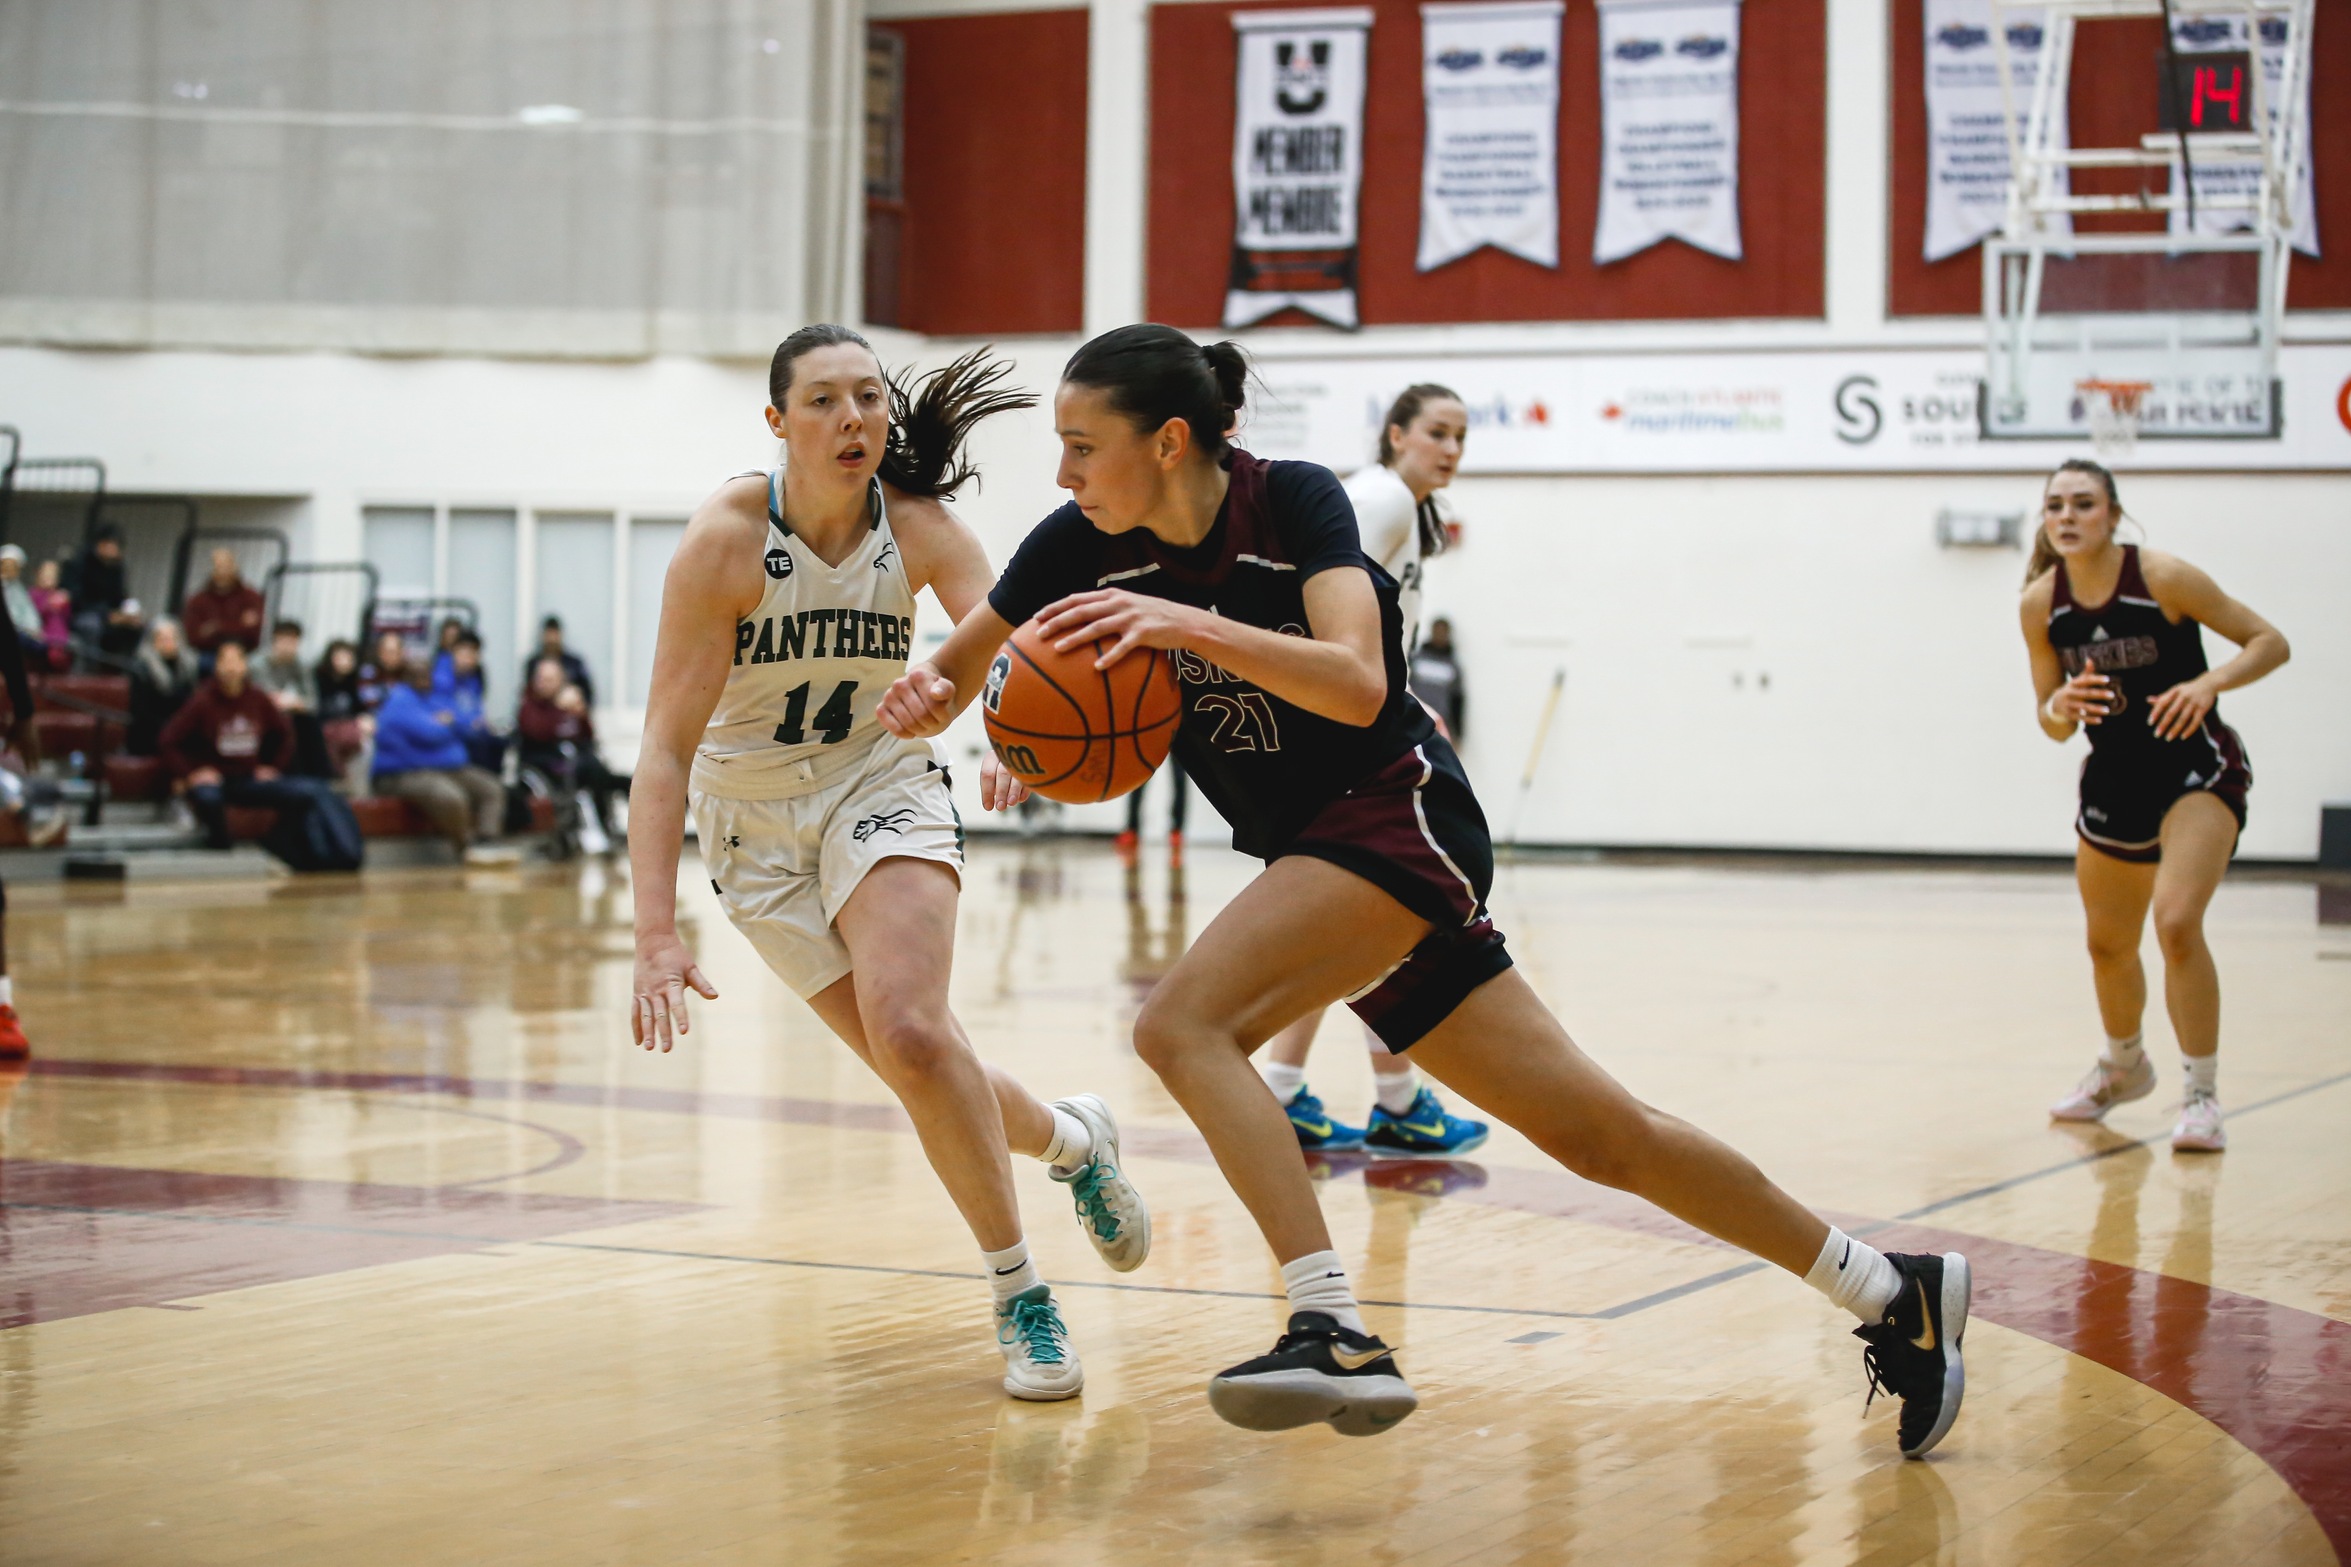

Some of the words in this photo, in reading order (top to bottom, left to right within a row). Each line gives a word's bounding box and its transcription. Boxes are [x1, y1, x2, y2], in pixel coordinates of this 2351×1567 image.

[2189, 66, 2243, 126] 14
[1254, 125, 1343, 175] MEMBER
[766, 556, 791, 573] TE
[733, 608, 911, 666] PANTHERS
[773, 680, 859, 744] 14
[1194, 692, 1282, 753] 21
